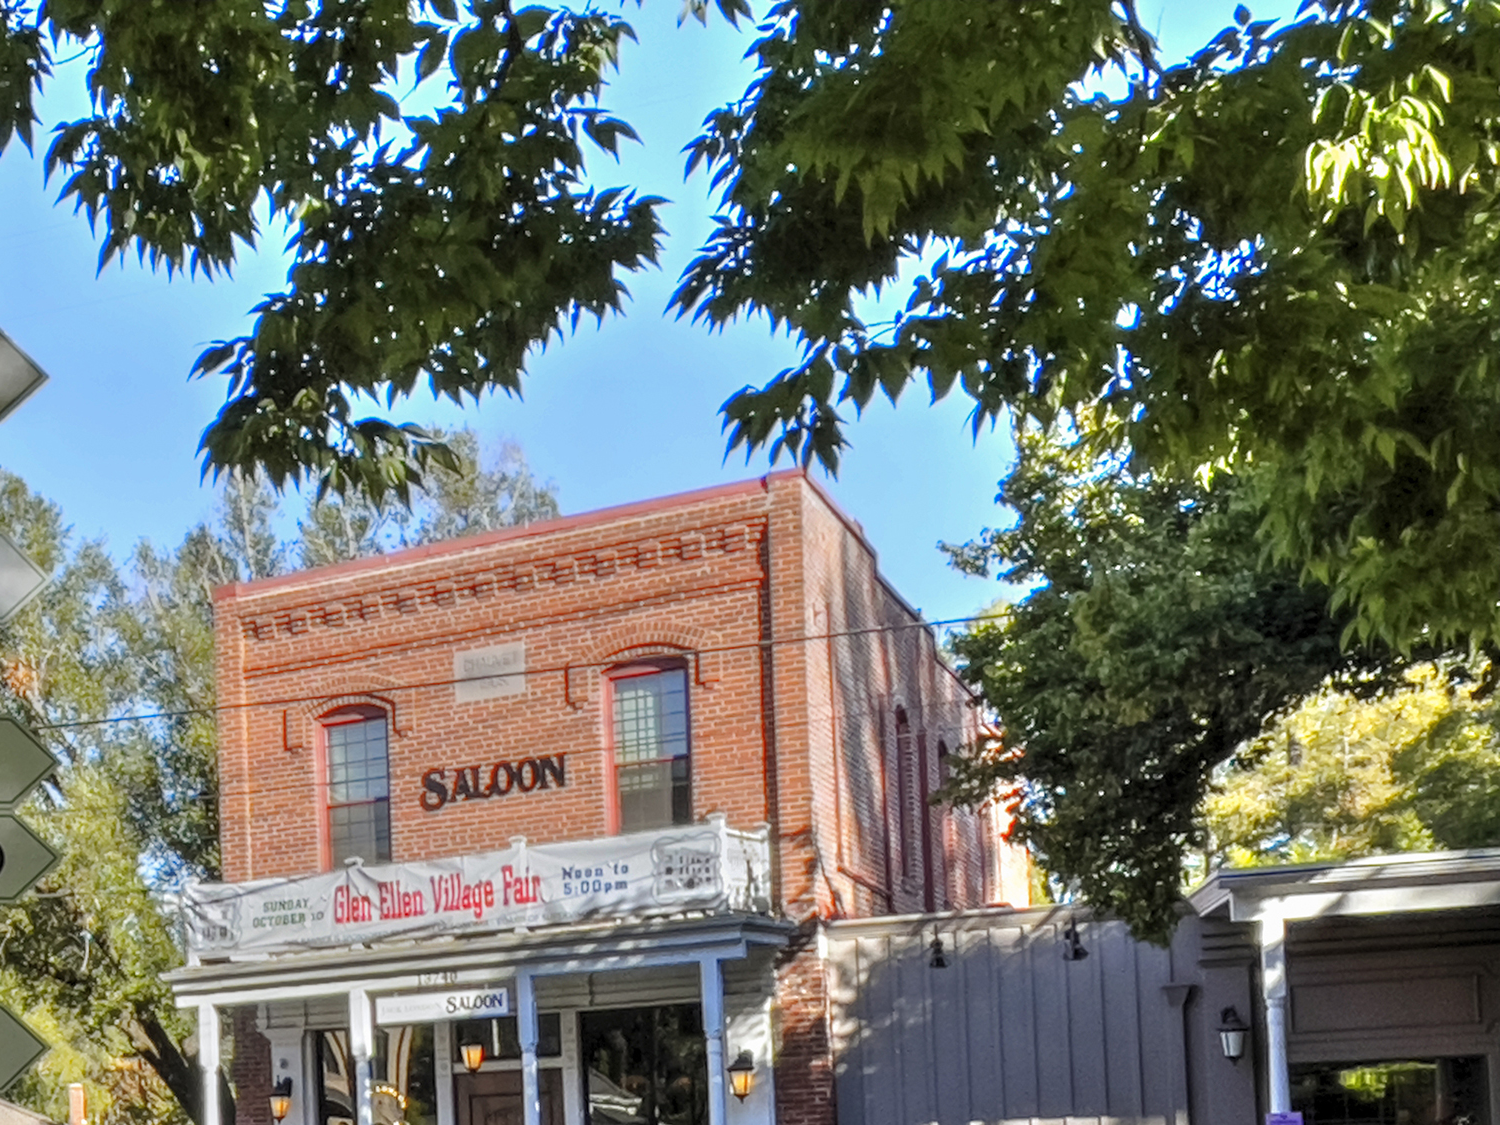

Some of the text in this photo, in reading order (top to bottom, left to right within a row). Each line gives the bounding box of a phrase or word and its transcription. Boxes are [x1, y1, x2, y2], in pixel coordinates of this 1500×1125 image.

[419, 752, 568, 812] SALOON
[561, 863, 629, 880] Noon to
[334, 885, 373, 924] Glen
[377, 880, 426, 921] Ellen
[429, 872, 495, 920] Village
[501, 865, 541, 907] Fair
[563, 879, 628, 896] 5:00pm
[253, 914, 306, 929] OCTOBER
[446, 992, 504, 1014] SALOON
